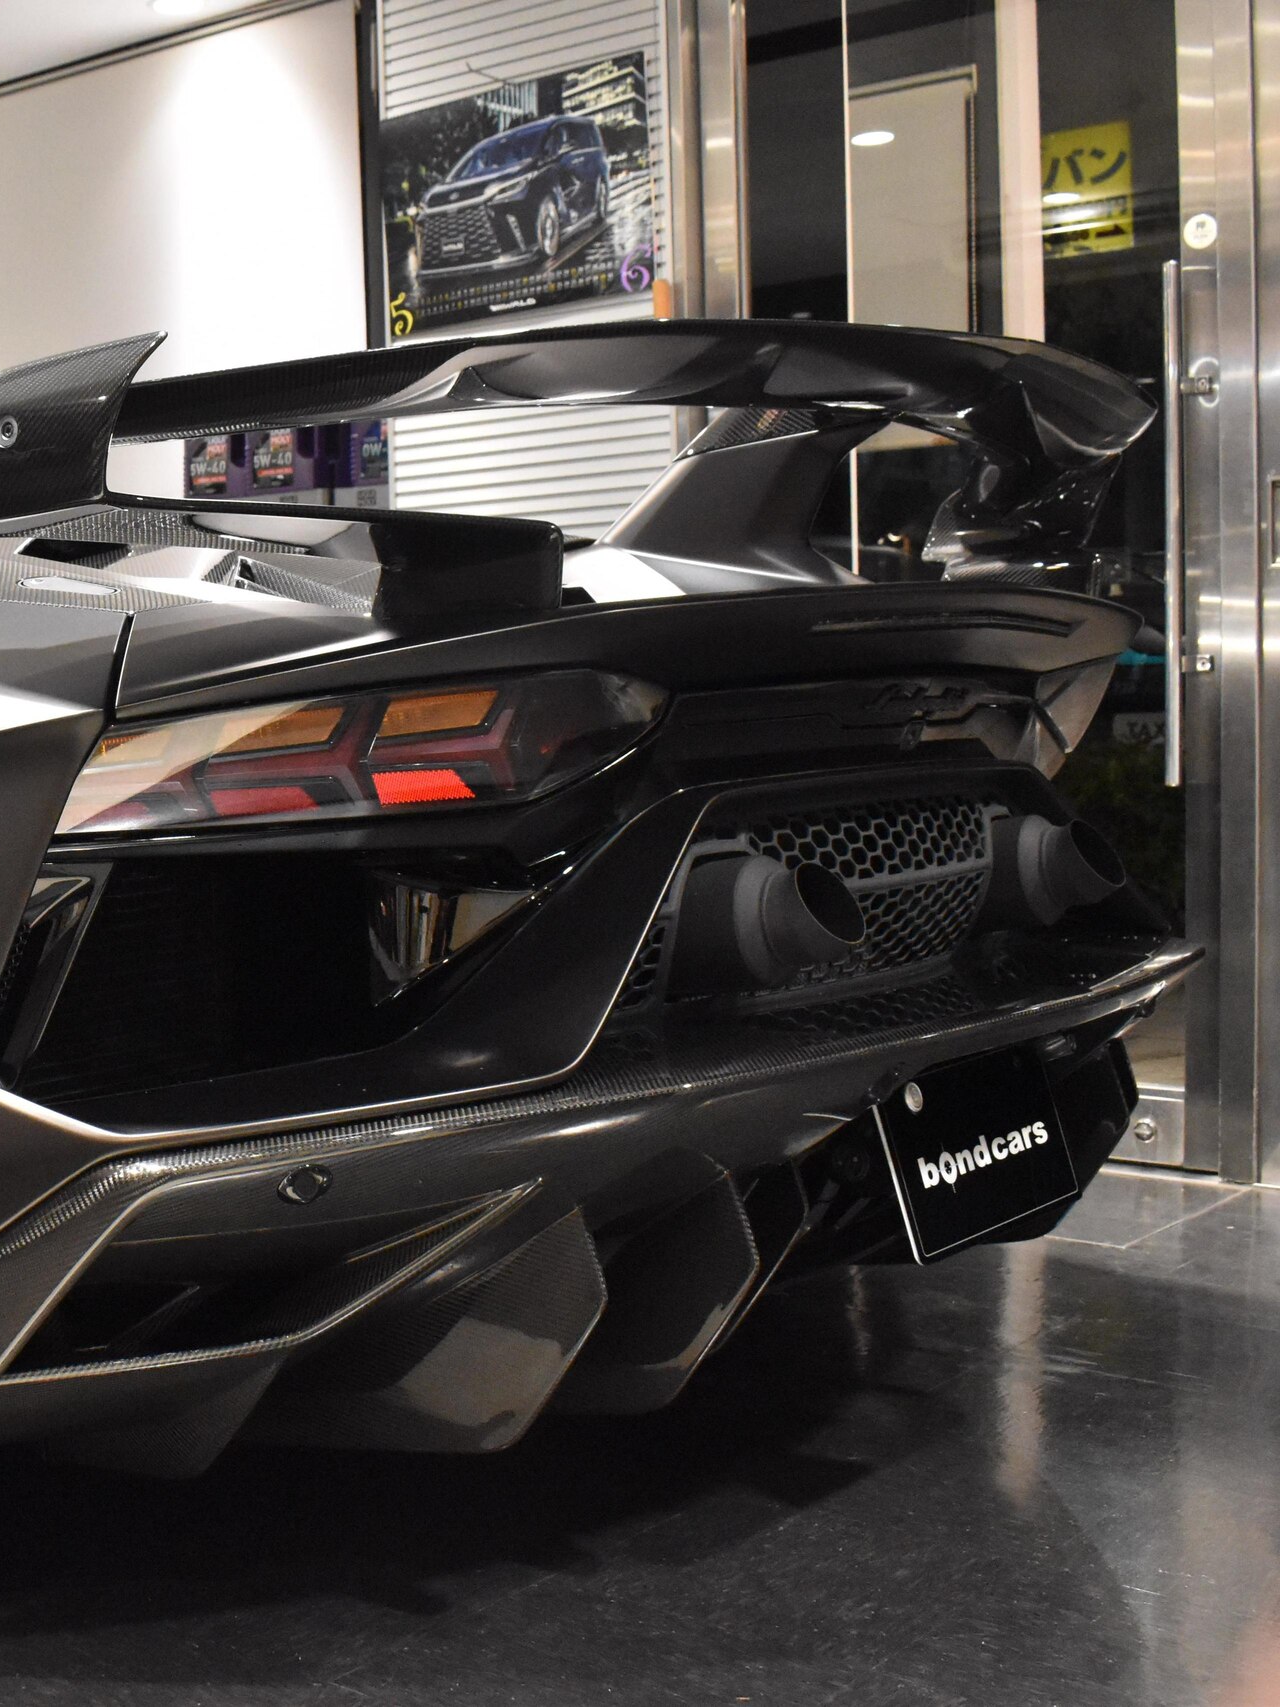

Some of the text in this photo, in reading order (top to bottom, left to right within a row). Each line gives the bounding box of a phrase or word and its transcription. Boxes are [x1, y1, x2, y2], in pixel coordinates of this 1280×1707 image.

[620, 243, 652, 292] 6
[390, 292, 413, 336] 5
[190, 460, 227, 477] 5W-40
[253, 452, 293, 469] 5W-40
